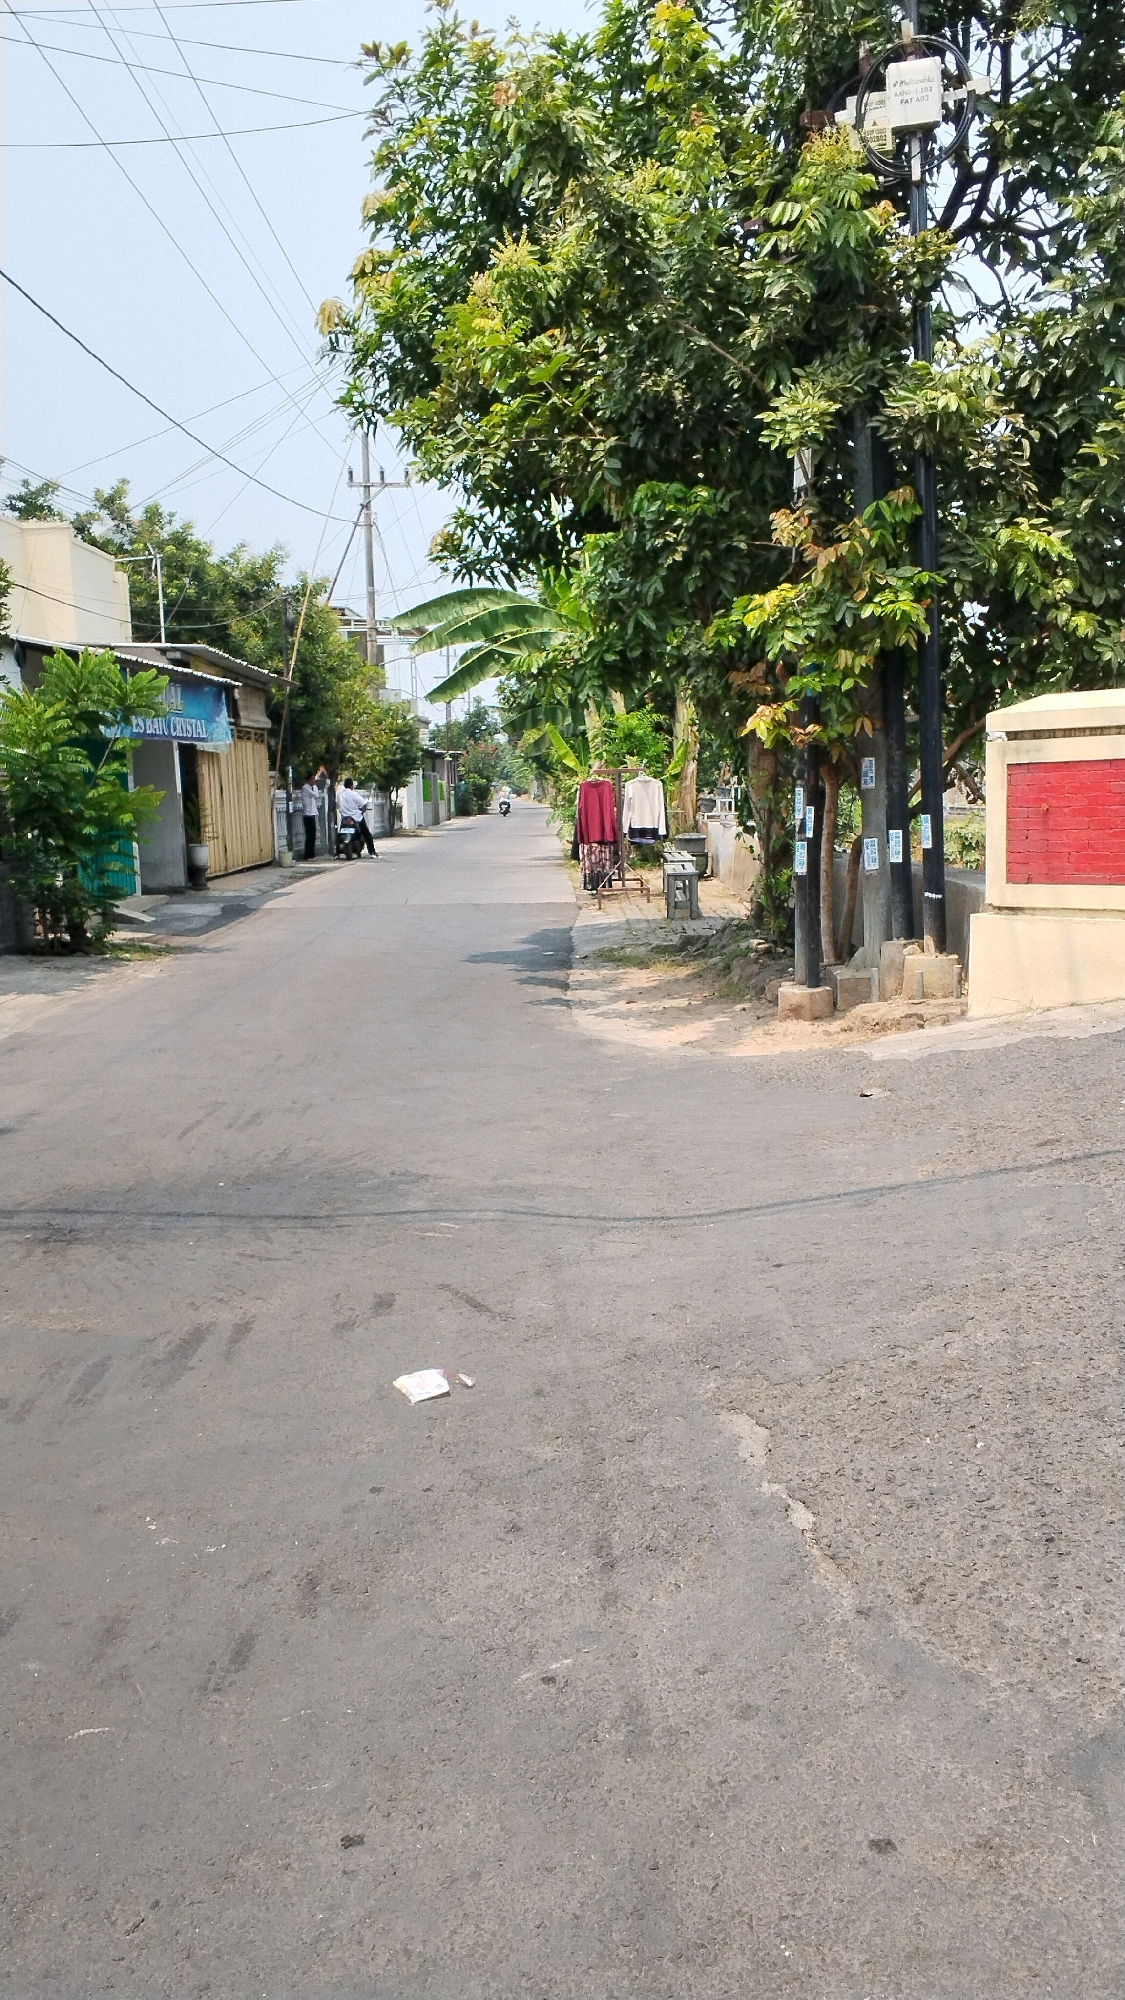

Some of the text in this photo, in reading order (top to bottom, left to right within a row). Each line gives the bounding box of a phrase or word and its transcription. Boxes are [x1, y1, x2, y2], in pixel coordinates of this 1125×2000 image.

[900, 97, 914, 106] FAT
[132, 715, 145, 733] ES
[170, 716, 209, 738] CRYSTAL
